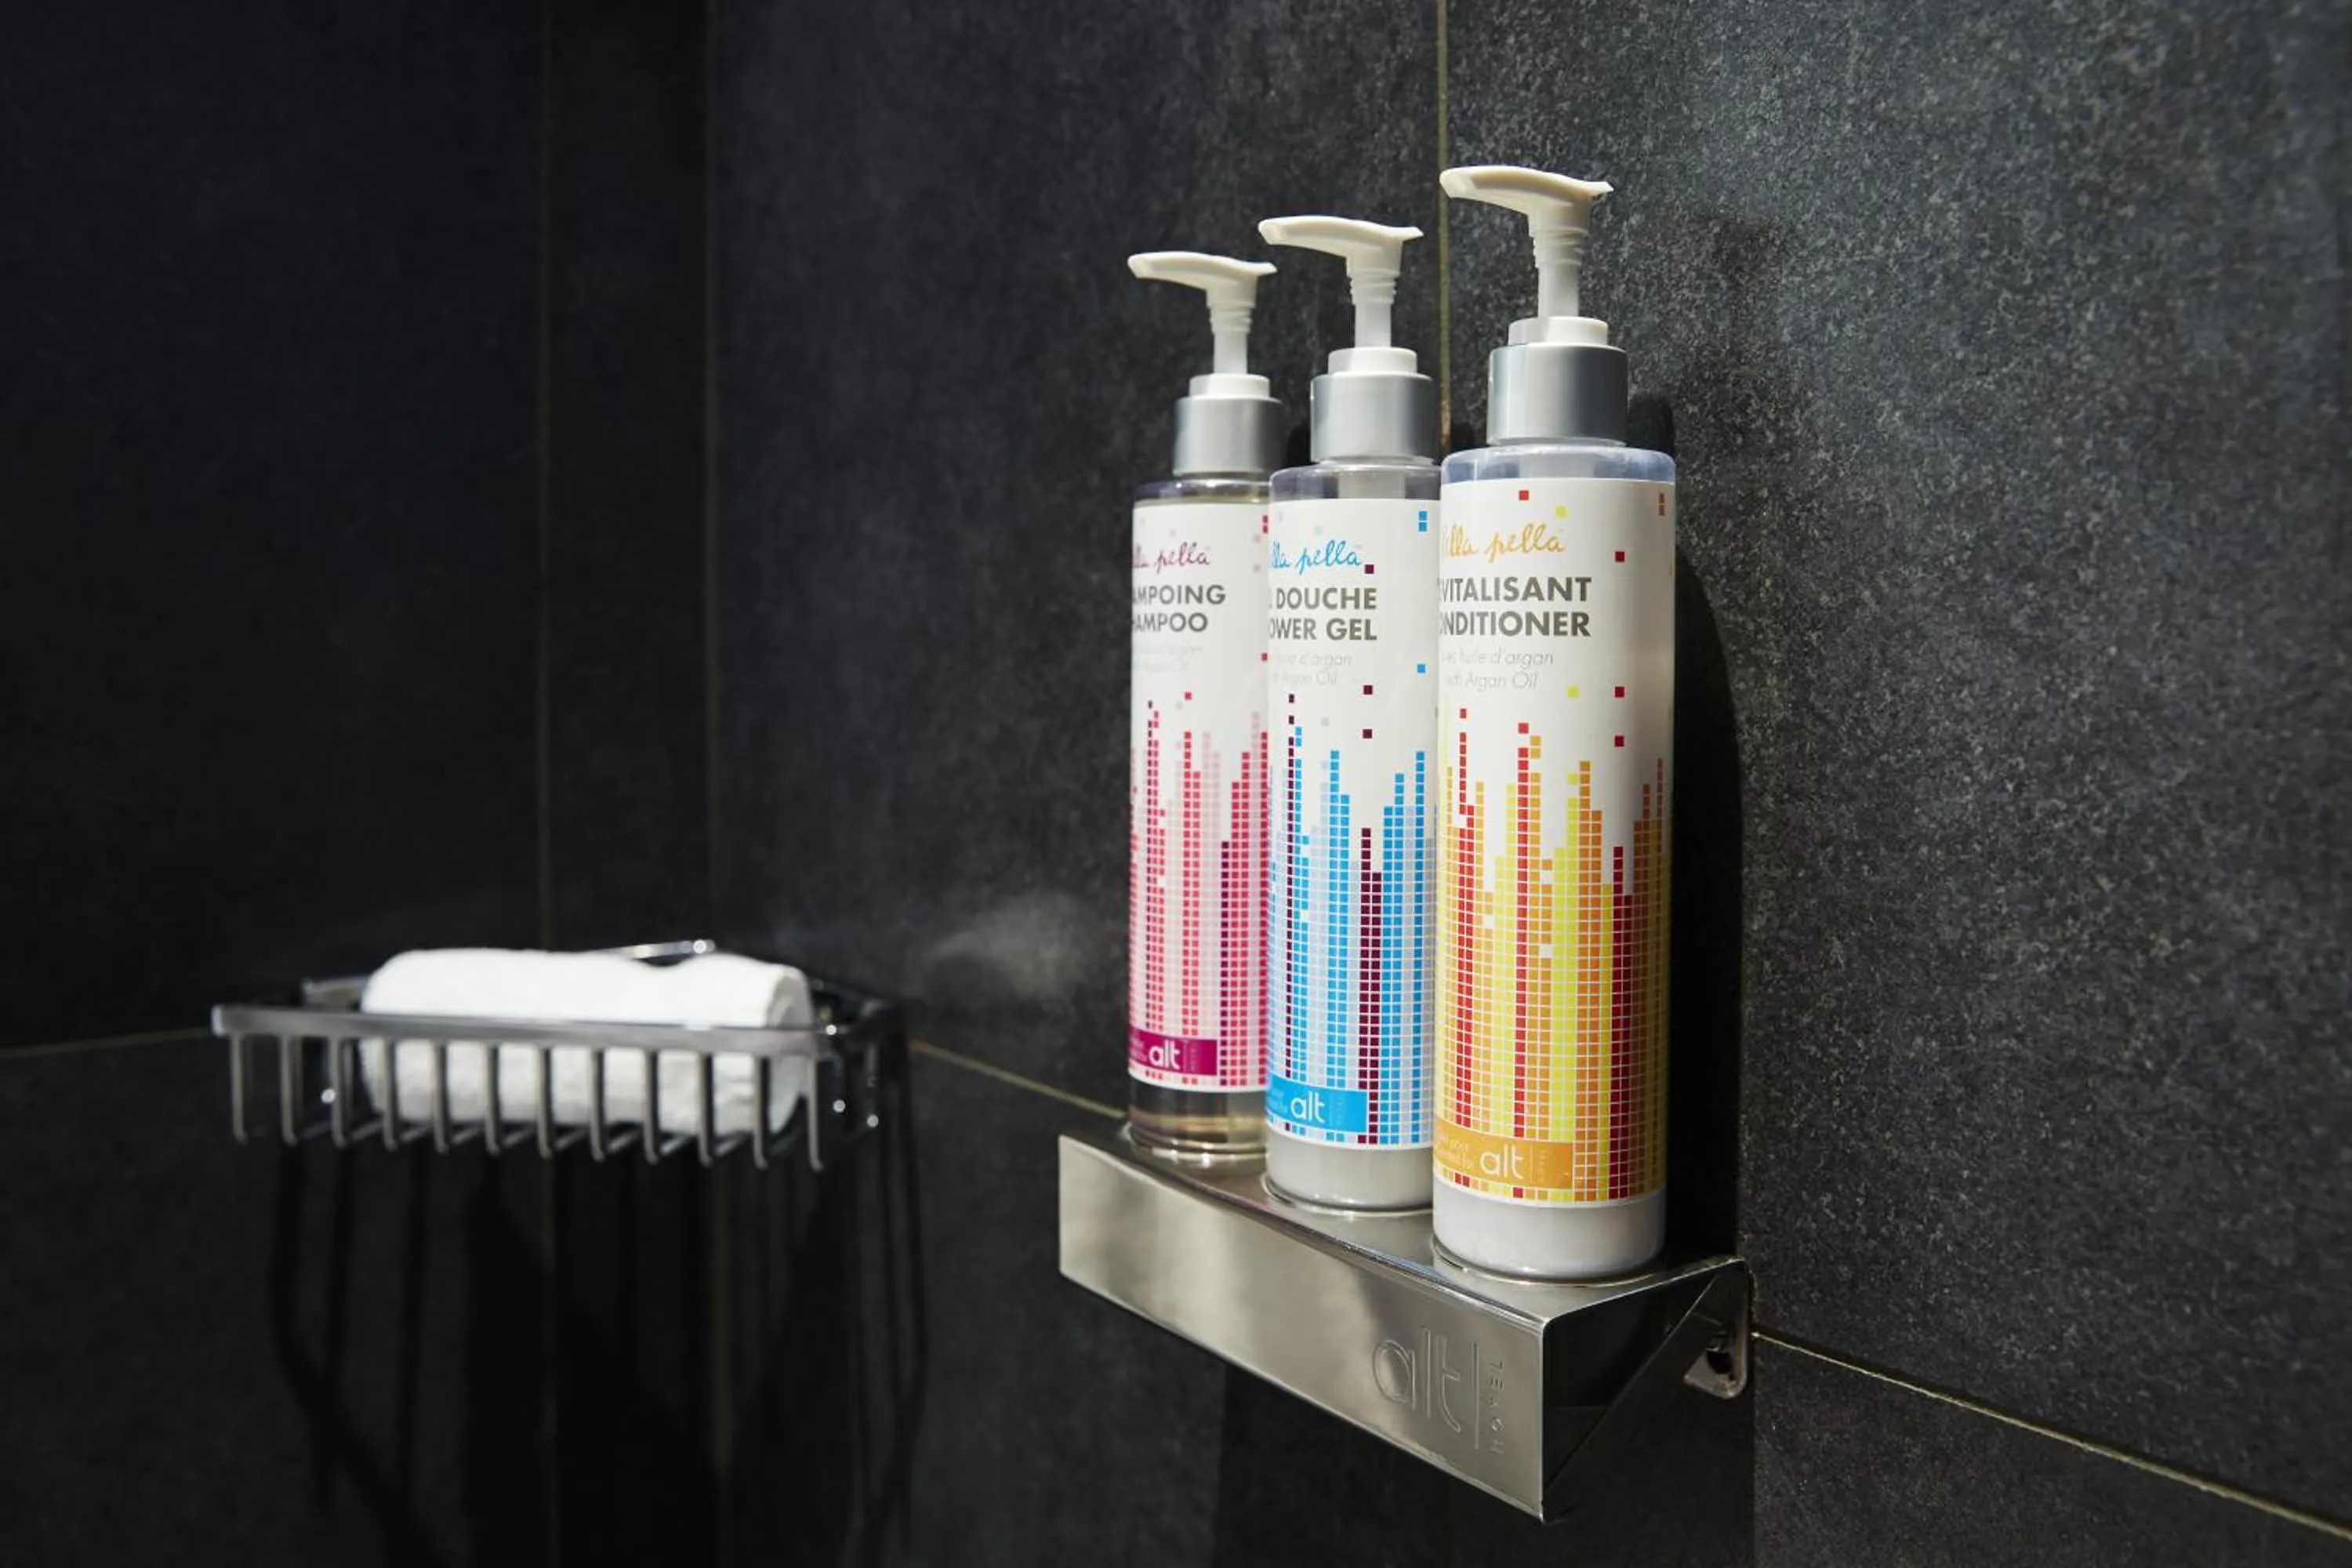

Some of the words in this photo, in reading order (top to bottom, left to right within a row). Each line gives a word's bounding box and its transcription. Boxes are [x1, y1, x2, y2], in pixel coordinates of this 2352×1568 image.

[1155, 542, 1210, 574] pella
[1296, 539, 1361, 575] pella
[1446, 524, 1478, 557] lla
[1485, 524, 1566, 562] pella
[1276, 587, 1377, 610] DOUCHE
[1437, 576, 1592, 602] VITALISANT
[1326, 618, 1377, 641] GEL
[1512, 670, 1539, 690] Oil
[1148, 1040, 1181, 1069] alt
[1290, 1091, 1326, 1123] alt
[1479, 1144, 1525, 1180] alt
[1374, 1327, 1462, 1434] alt
